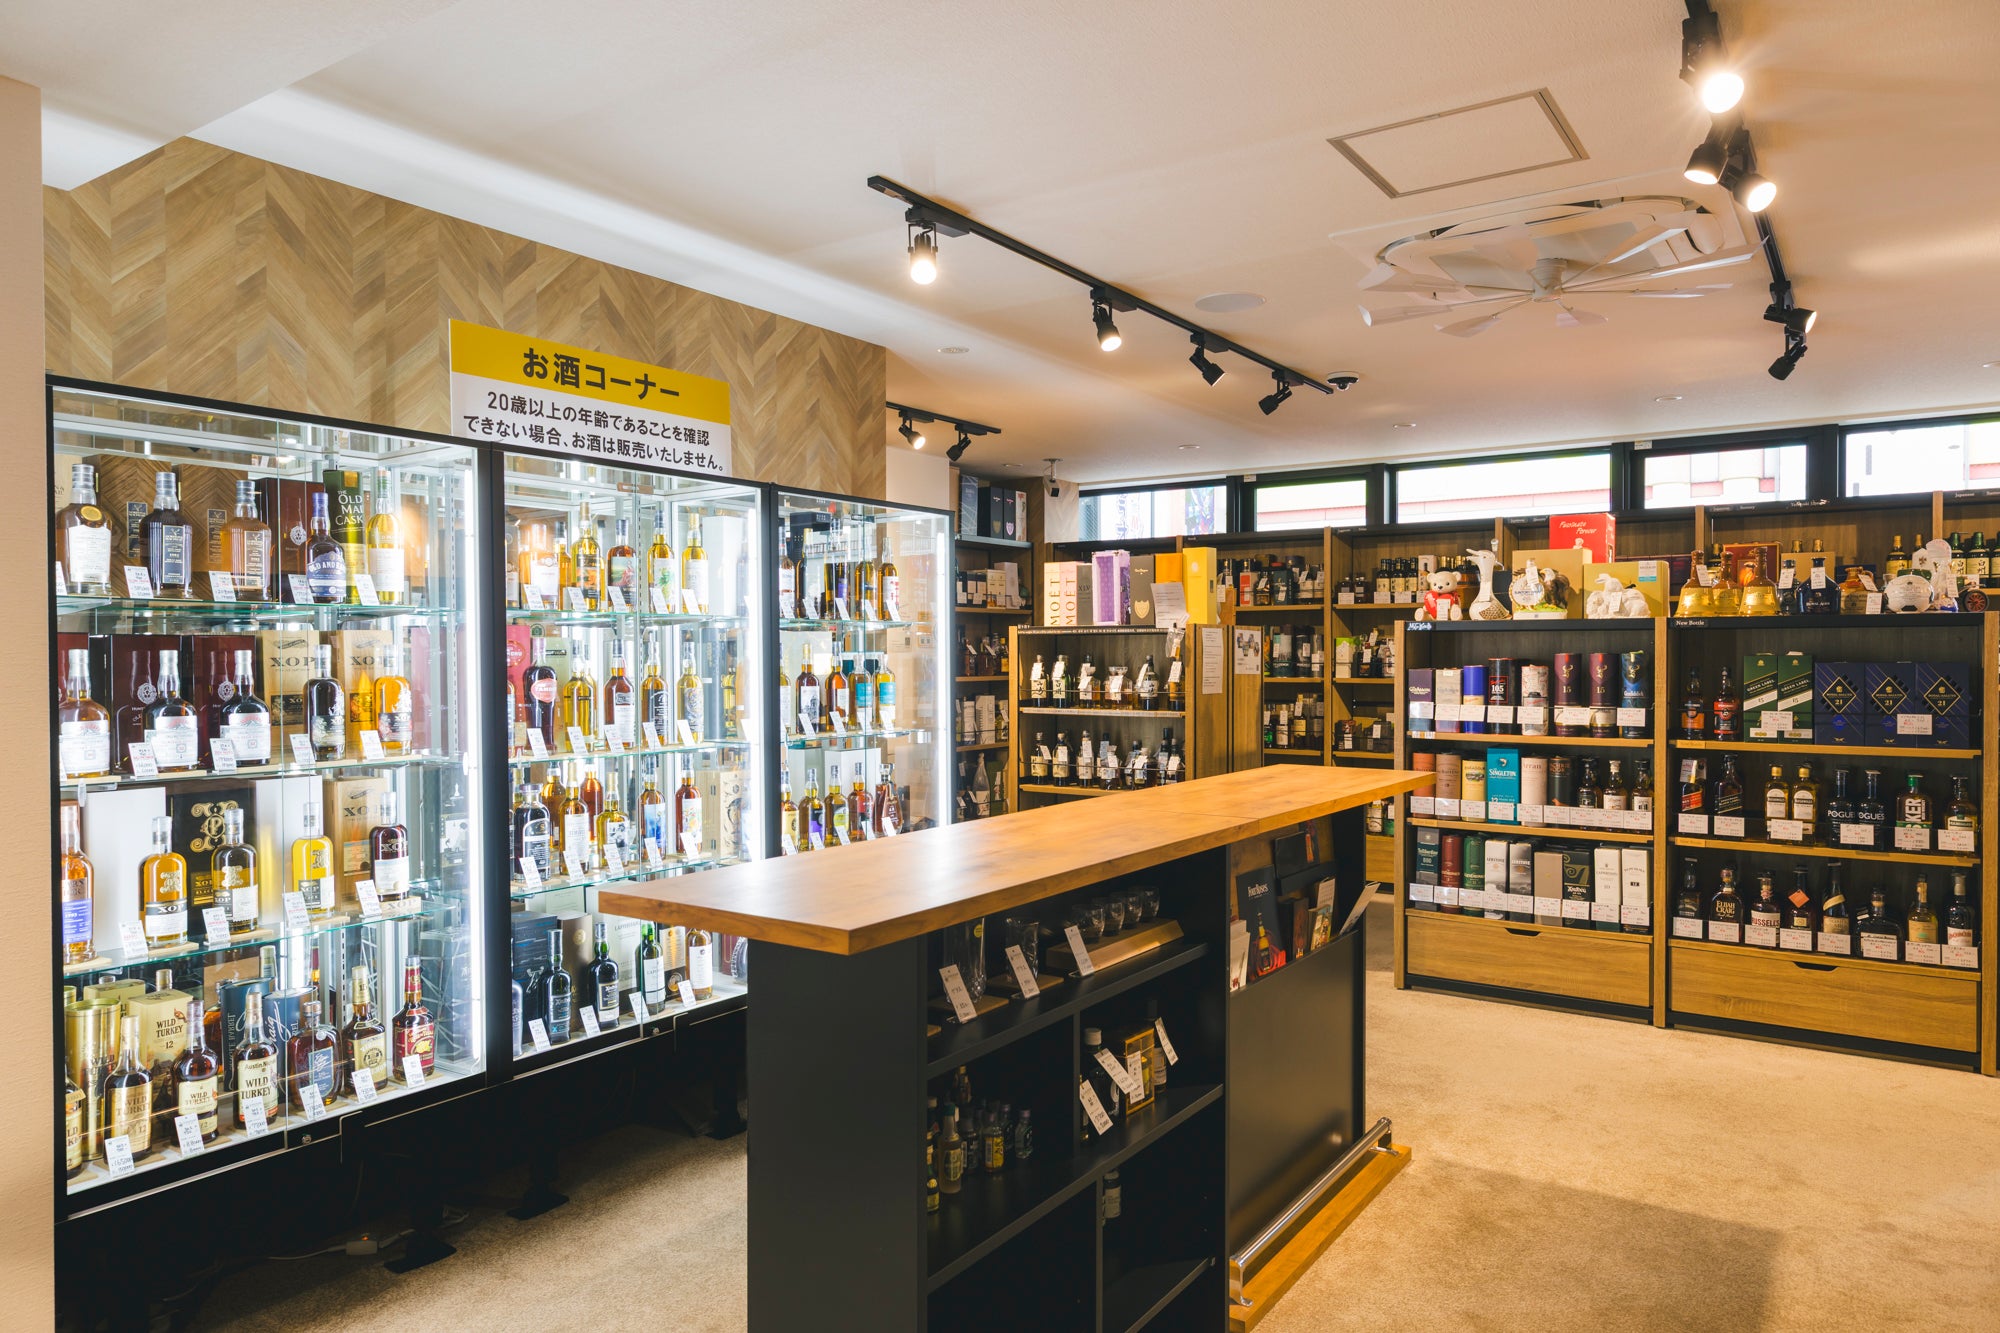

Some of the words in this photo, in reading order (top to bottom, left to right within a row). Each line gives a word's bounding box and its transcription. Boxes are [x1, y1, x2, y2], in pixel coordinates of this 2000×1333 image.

[522, 347, 680, 400] お酒コーナー
[487, 391, 710, 447] 20歳以上の年齢であることを確認
[463, 415, 724, 472] できない場合、お酒は販売いたしません。
[338, 495, 363, 505] OLD
[335, 515, 364, 526] CASK
[1491, 685, 1504, 693] 105
[1563, 685, 1572, 693] 15
[1827, 809, 1854, 819] POGUE
[156, 1019, 176, 1029] WILD
[156, 1024, 184, 1038] TURKEY
[165, 1041, 174, 1049] 12
[245, 1077, 269, 1088] WILD
[190, 1091, 208, 1099] WILD
[241, 1089, 271, 1099] TURKEY
[117, 1104, 147, 1115] TURKE
[139, 1124, 147, 1133] 12
